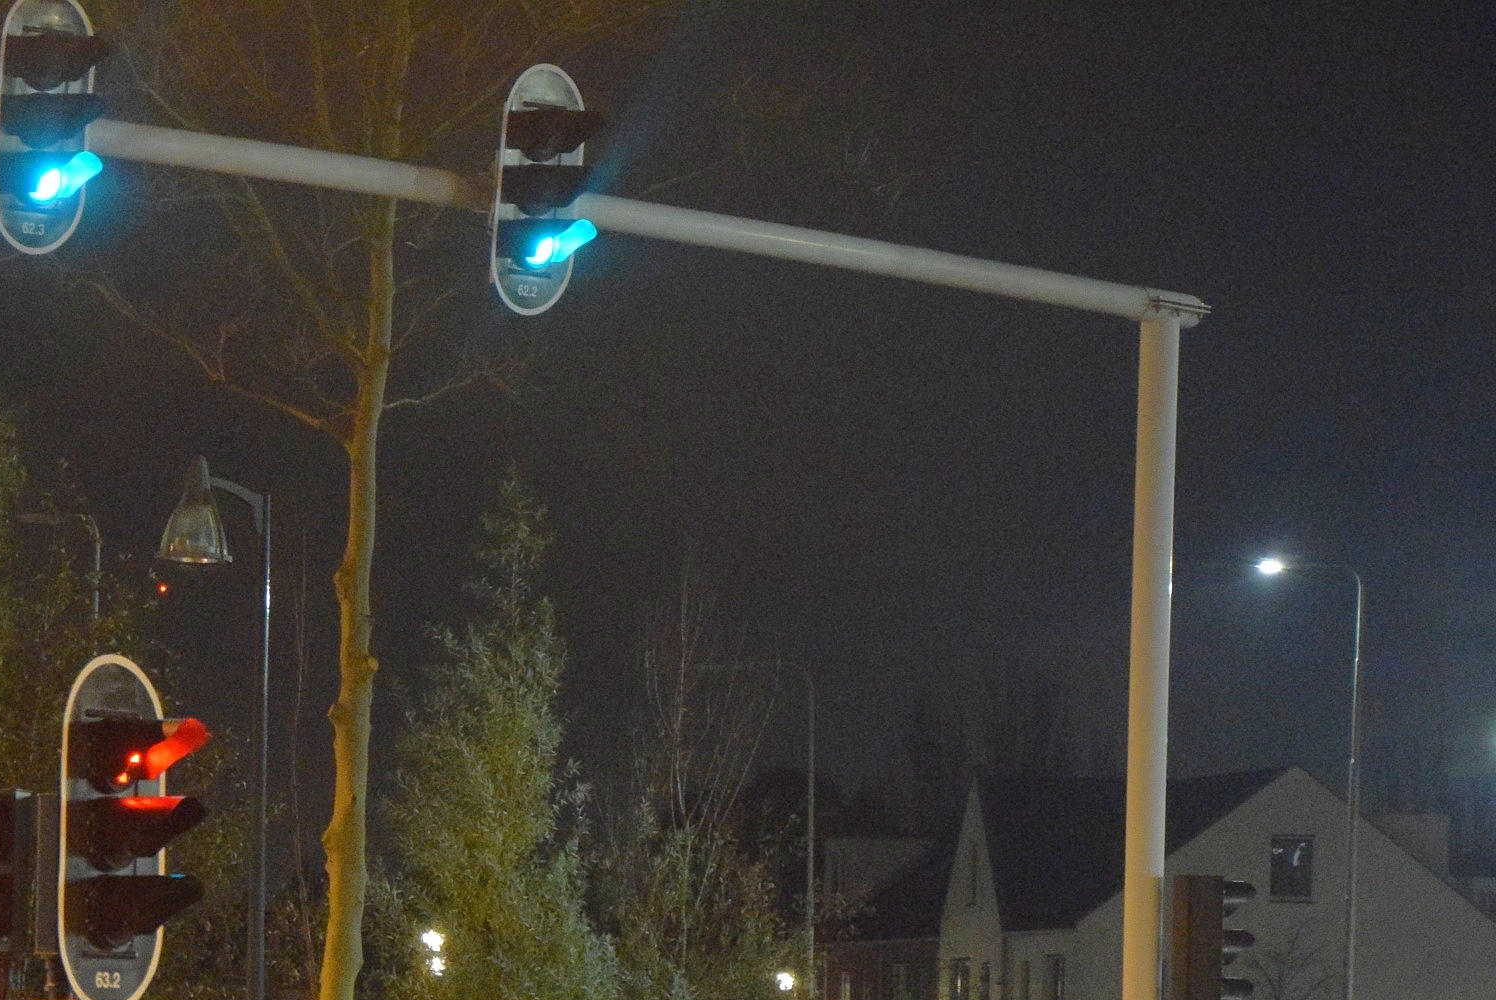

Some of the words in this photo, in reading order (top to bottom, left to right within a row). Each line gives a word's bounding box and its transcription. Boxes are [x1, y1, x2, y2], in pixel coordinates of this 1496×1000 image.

[22, 221, 45, 236] 62.3
[517, 284, 538, 297] 62.2
[95, 971, 121, 989] 63.2
